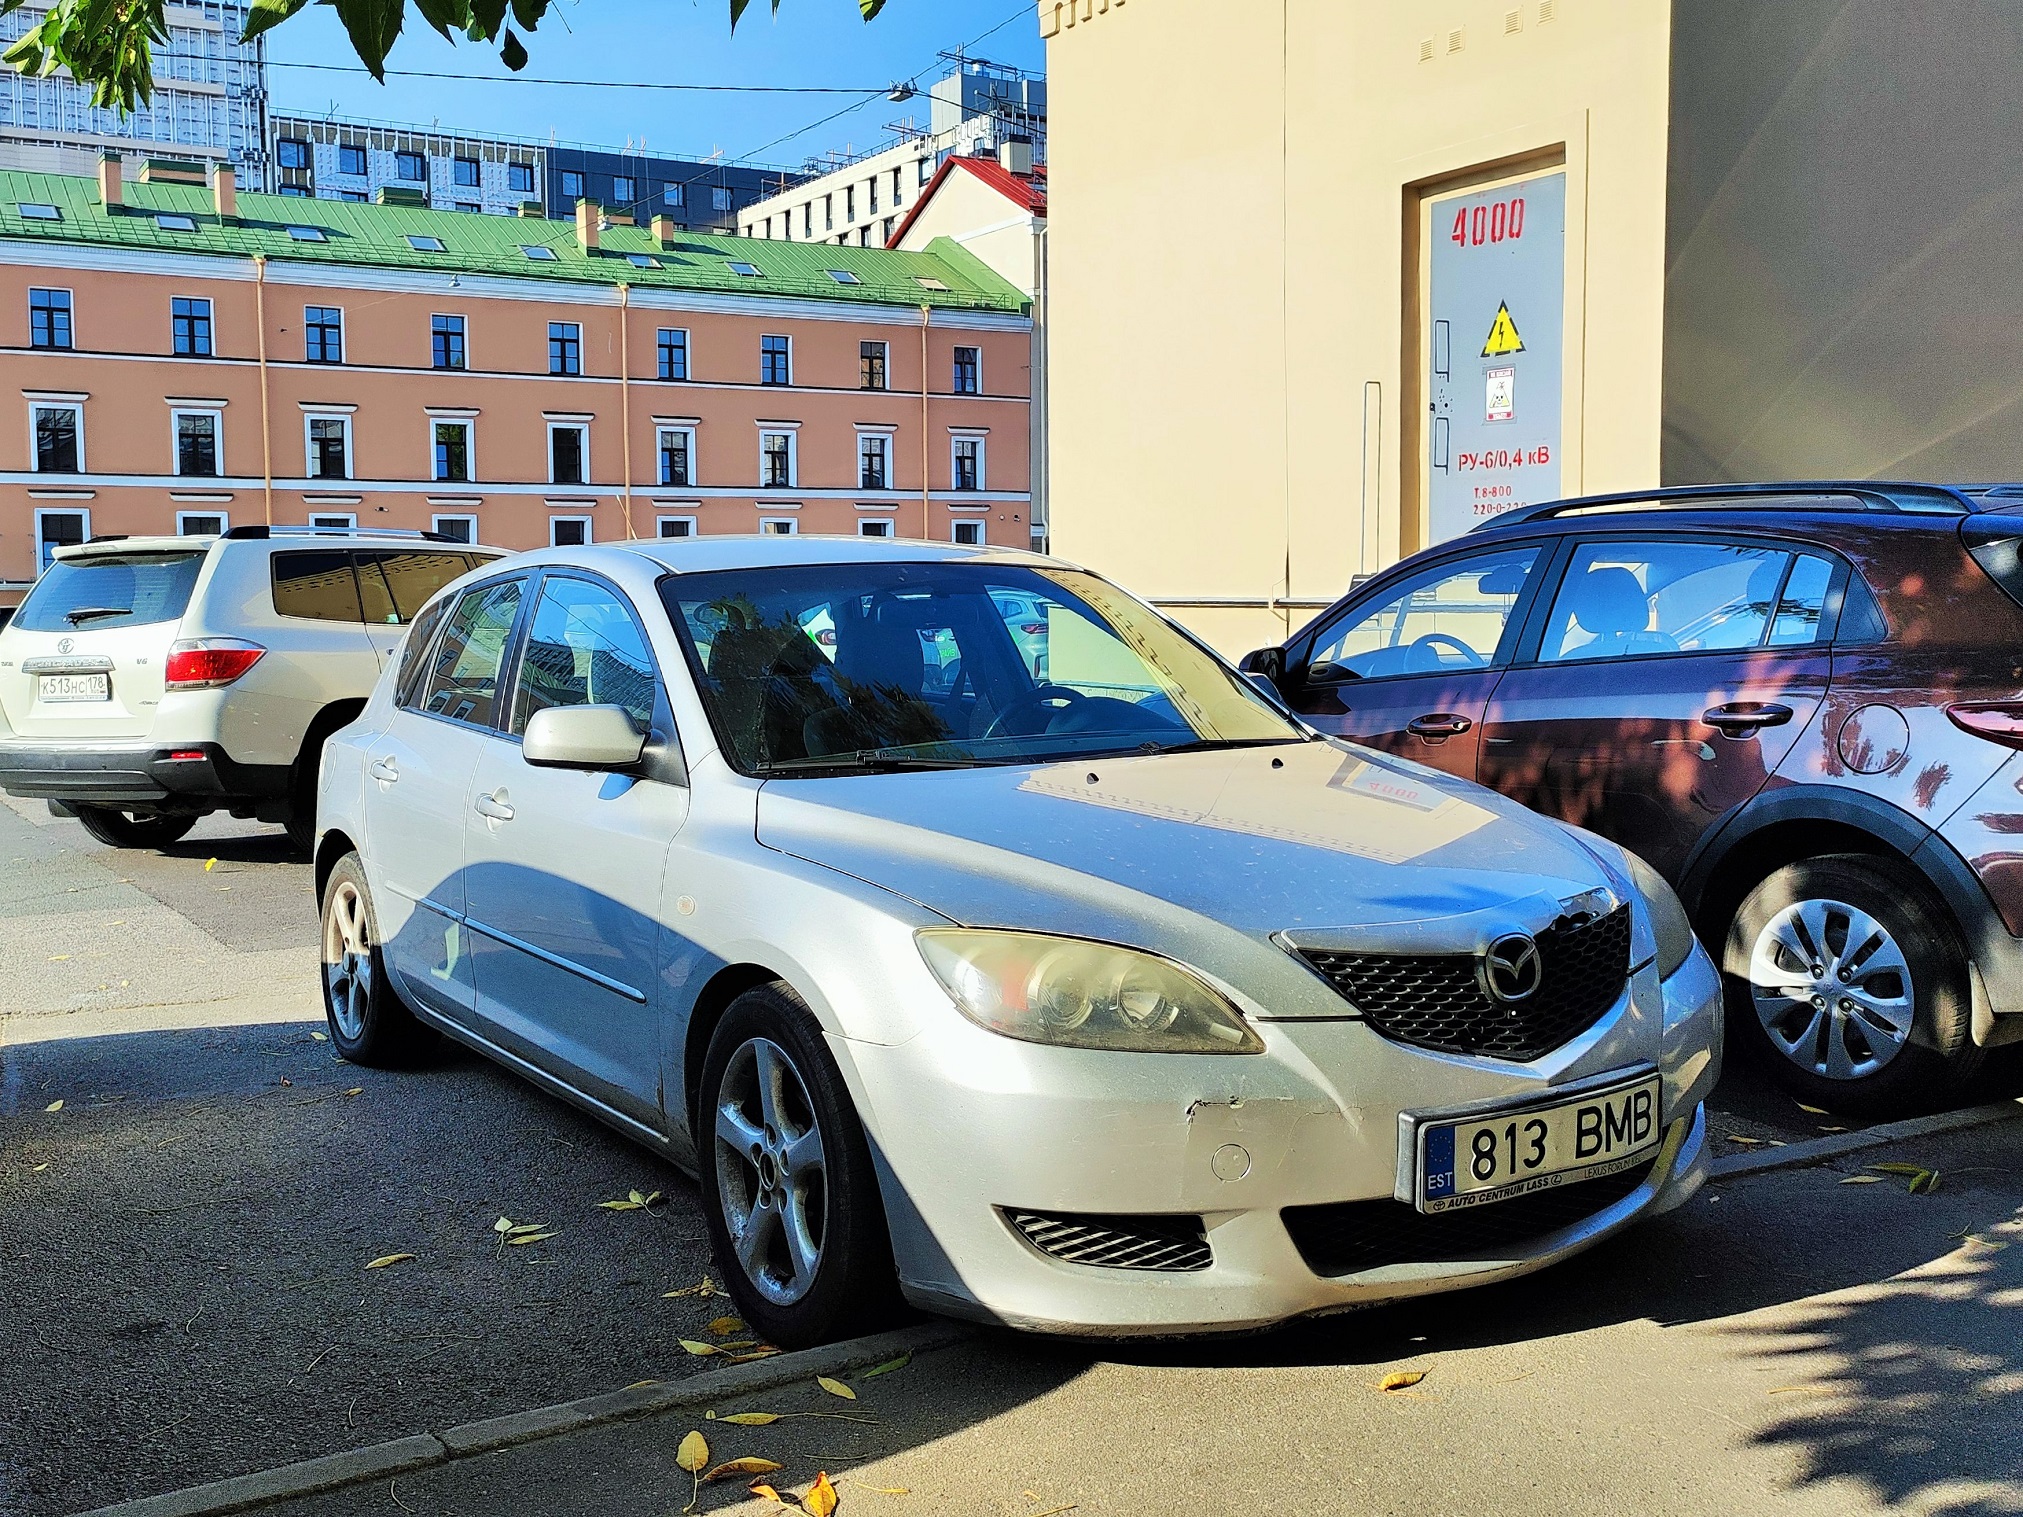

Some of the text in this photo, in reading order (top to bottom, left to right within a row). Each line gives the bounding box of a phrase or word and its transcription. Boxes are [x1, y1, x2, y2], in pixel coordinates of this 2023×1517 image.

[1451, 198, 1525, 248] 4000
[1458, 446, 1549, 471] РУ-6/0,4 кВ
[87, 676, 104, 689] 178
[1471, 1089, 1652, 1181] 813 BMB
[1427, 1172, 1453, 1190] EST
[1584, 1165, 1607, 1179] LEXUS
[1447, 1177, 1549, 1208] AUTO CENTRUM LASS
